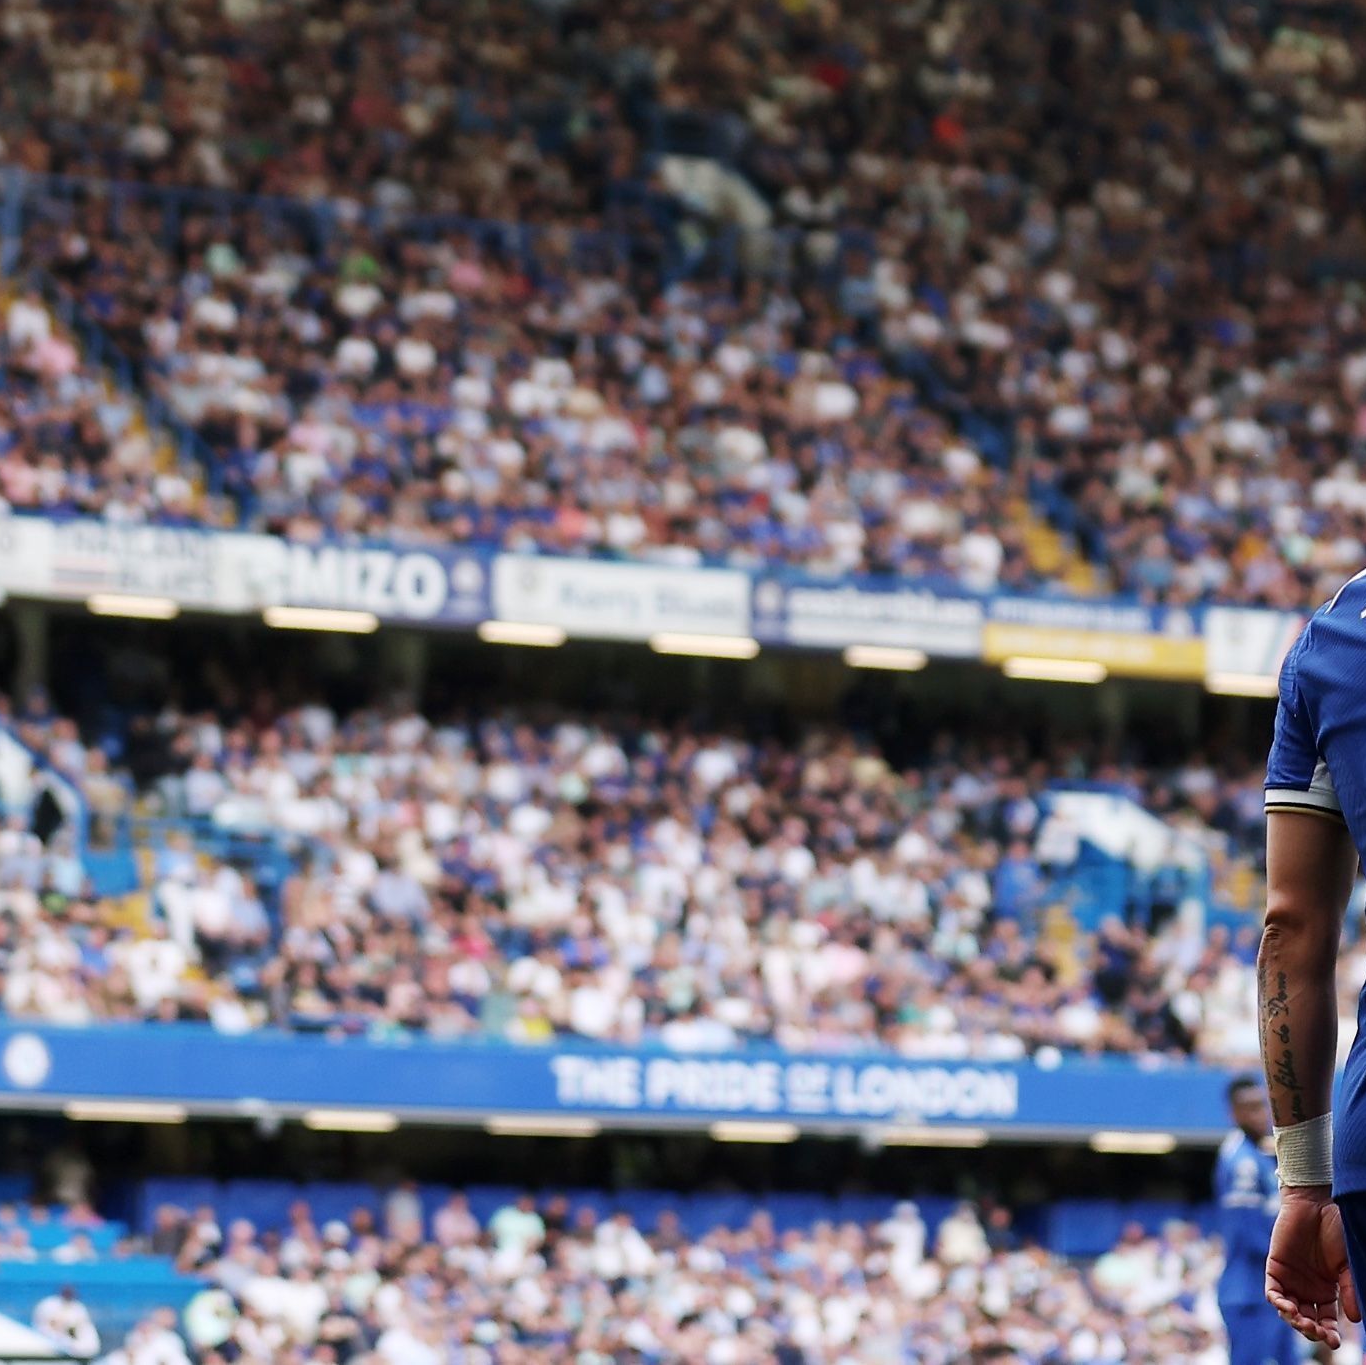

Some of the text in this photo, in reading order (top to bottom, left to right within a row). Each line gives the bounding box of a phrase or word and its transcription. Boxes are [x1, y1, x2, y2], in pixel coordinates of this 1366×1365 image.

[550, 1054, 1019, 1120] THE PRIDE OF LONDON
